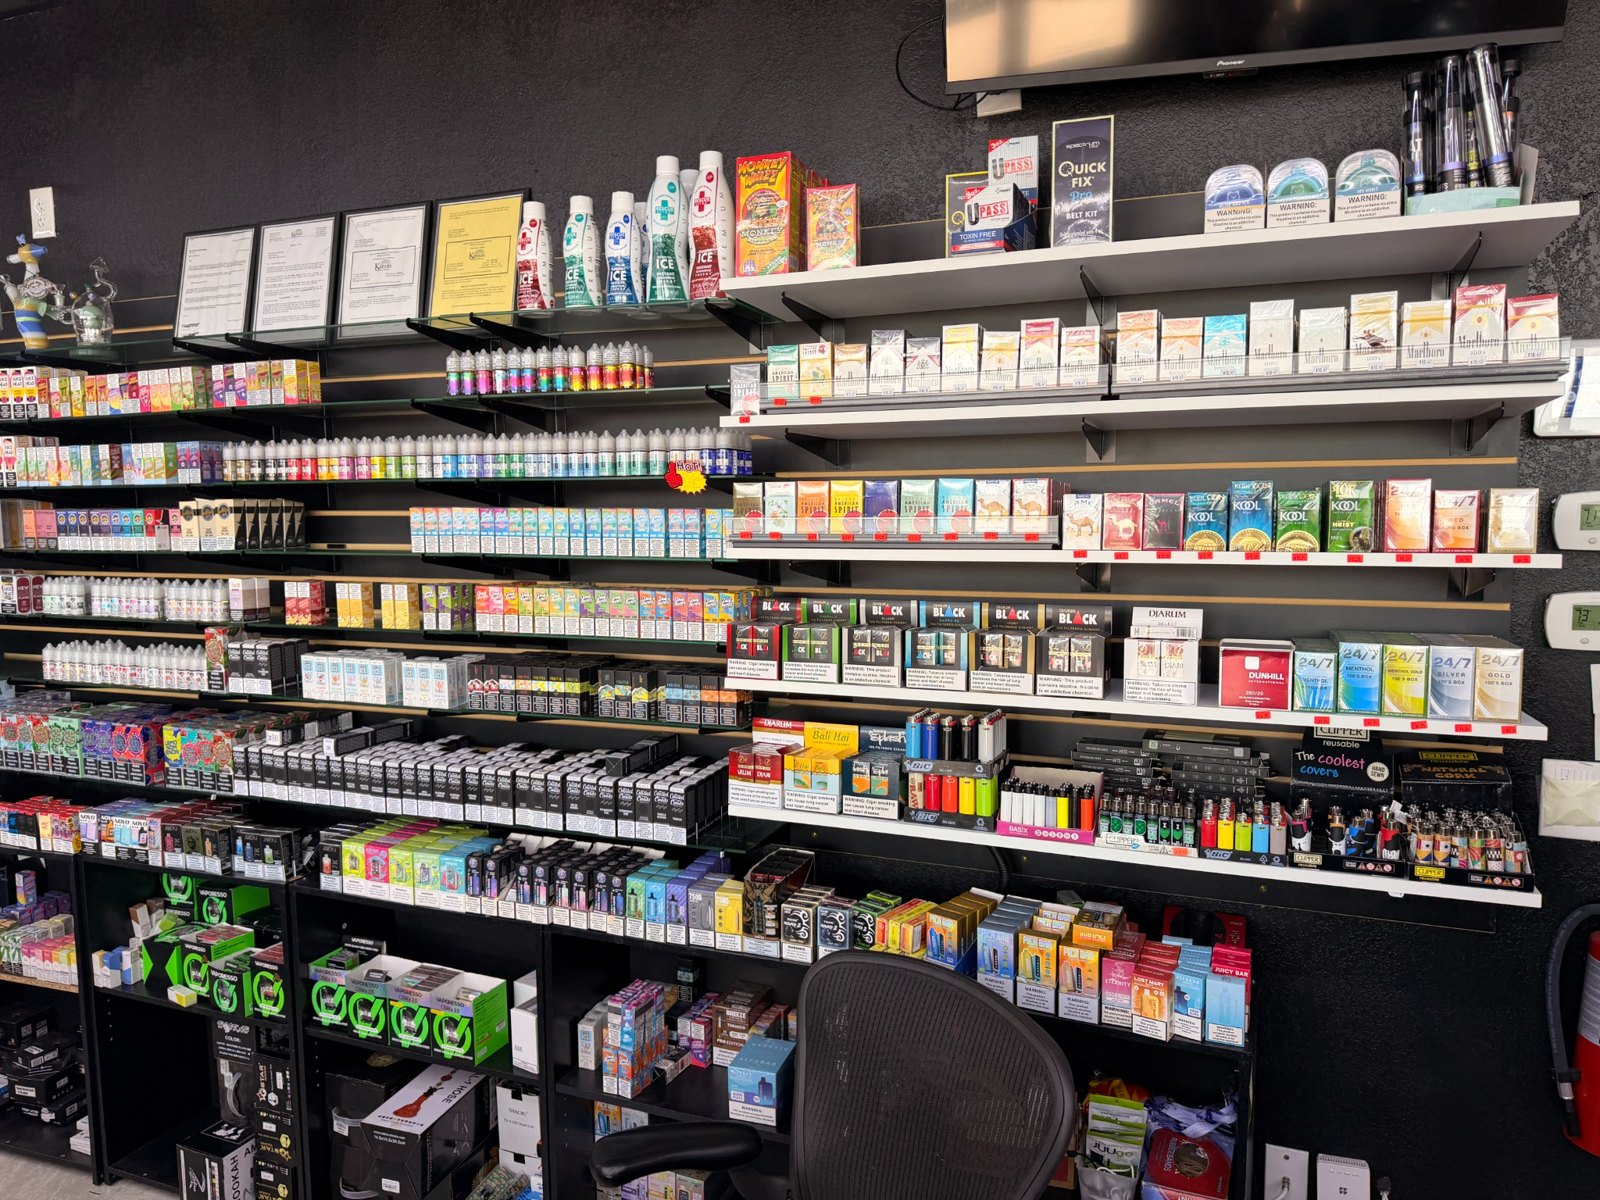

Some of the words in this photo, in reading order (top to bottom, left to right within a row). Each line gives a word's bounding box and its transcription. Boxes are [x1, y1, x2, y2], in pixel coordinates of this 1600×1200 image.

[738, 157, 788, 177] MONKEY
[1005, 158, 1031, 173] PASS
[1059, 161, 1106, 176] QUICK
[1070, 191, 1093, 203] Pro
[1348, 194, 1387, 203] WARNING:
[980, 204, 1008, 218] PASS
[1217, 208, 1252, 216] WARNING:
[1280, 202, 1317, 211] WARNING:
[1066, 211, 1083, 220] BELT
[698, 252, 713, 263] ICE
[656, 259, 674, 269] ICE
[520, 273, 534, 284] ICE
[566, 269, 579, 279] ICE
[610, 270, 627, 281] ICE
[1458, 331, 1500, 348] Marlboro
[1511, 334, 1558, 354] Marlboro
[1254, 344, 1288, 359] Marlboro
[1304, 347, 1339, 364] Marlboro
[1407, 342, 1445, 358] Marlboro
[1120, 351, 1154, 367] Marlboro
[1164, 354, 1199, 369] Marlboro
[1207, 349, 1243, 366] Marlboro
[1023, 358, 1054, 370] Marlboro
[1064, 361, 1096, 373] Marlboro
[985, 367, 1014, 382] Marlboro
[676, 461, 702, 472] HOT!
[904, 505, 929, 513] SPIRIT
[1066, 500, 1100, 510] CAMEL
[1233, 500, 1261, 511] KOOL
[1331, 501, 1361, 511] KOOL
[1188, 511, 1216, 522] KOOL
[1279, 511, 1309, 522] KOOL
[762, 602, 790, 612] BLACK
[812, 602, 842, 614] BLACK
[872, 603, 903, 616] BLACK
[933, 604, 965, 618] BLACK
[995, 607, 1029, 620] BLACK
[1058, 610, 1097, 625] BLACK
[1576, 609, 1589, 622] 73
[1344, 648, 1378, 660] 24/7
[1388, 651, 1425, 662] 24/7
[1299, 657, 1333, 669] 24/7
[1434, 657, 1471, 669] 24/7
[1481, 654, 1520, 666] 24/7
[1249, 671, 1284, 680] DUNHILL
[812, 730, 832, 740] Bali
[834, 732, 850, 742] Hai
[1323, 739, 1360, 749] reusable
[1295, 752, 1315, 762] The
[1318, 754, 1365, 769] coolest
[1300, 766, 1339, 778] covers
[909, 784, 918, 808] RAW
[1417, 868, 1443, 877] CLIPPER
[199, 889, 227, 898] VAPORESSO
[351, 937, 374, 945] VAPORESSO
[185, 943, 206, 953] VAPORESSO
[255, 961, 278, 970] VAPORESSO
[1215, 967, 1233, 975] JUICY
[210, 970, 238, 982] VAPORESSO
[314, 968, 342, 976] VAPORESSO
[351, 979, 378, 989] VAPORESSO
[1149, 979, 1165, 987] MARY
[395, 987, 422, 998] VAPORESSO
[436, 997, 465, 1007] VAPORESSO
[726, 1010, 746, 1018] BREEZE
[442, 1085, 468, 1104] HOSE
